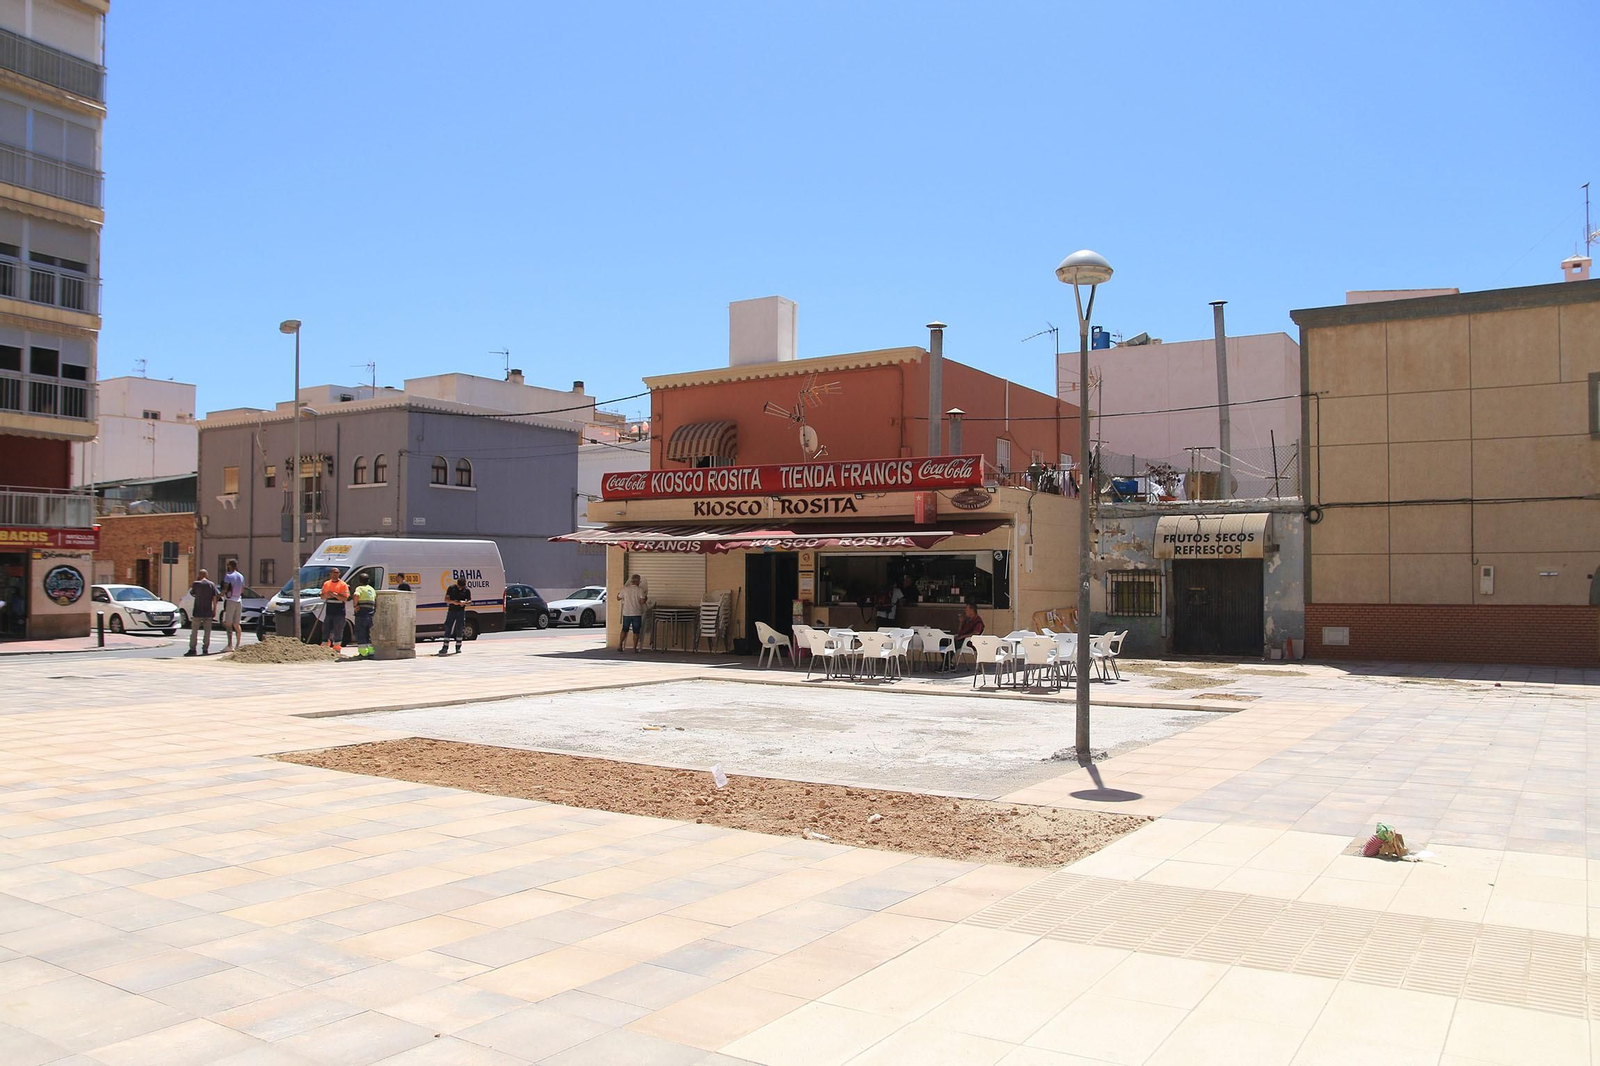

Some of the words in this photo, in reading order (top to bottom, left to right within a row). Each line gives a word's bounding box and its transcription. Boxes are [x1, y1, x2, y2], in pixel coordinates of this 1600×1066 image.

[779, 464, 837, 489] TIENDA
[841, 461, 914, 487] FRANCIS
[917, 457, 976, 480] Coca-Cola
[606, 472, 649, 491] Coca-Cola
[651, 470, 704, 493] KIOSCO
[707, 468, 762, 492] ROSITA
[693, 499, 762, 517] KIOSCO
[780, 497, 858, 515] ROSITA
[750, 537, 819, 549] KIOSCO
[838, 536, 907, 548] ROSITA
[1163, 533, 1210, 543] FRUTOS
[1215, 532, 1255, 542] SECOS
[635, 540, 701, 551] FRANCIS
[1174, 544, 1242, 555] REFRESCOS
[452, 569, 483, 580] BAHIA
[467, 580, 490, 588] QUILER
